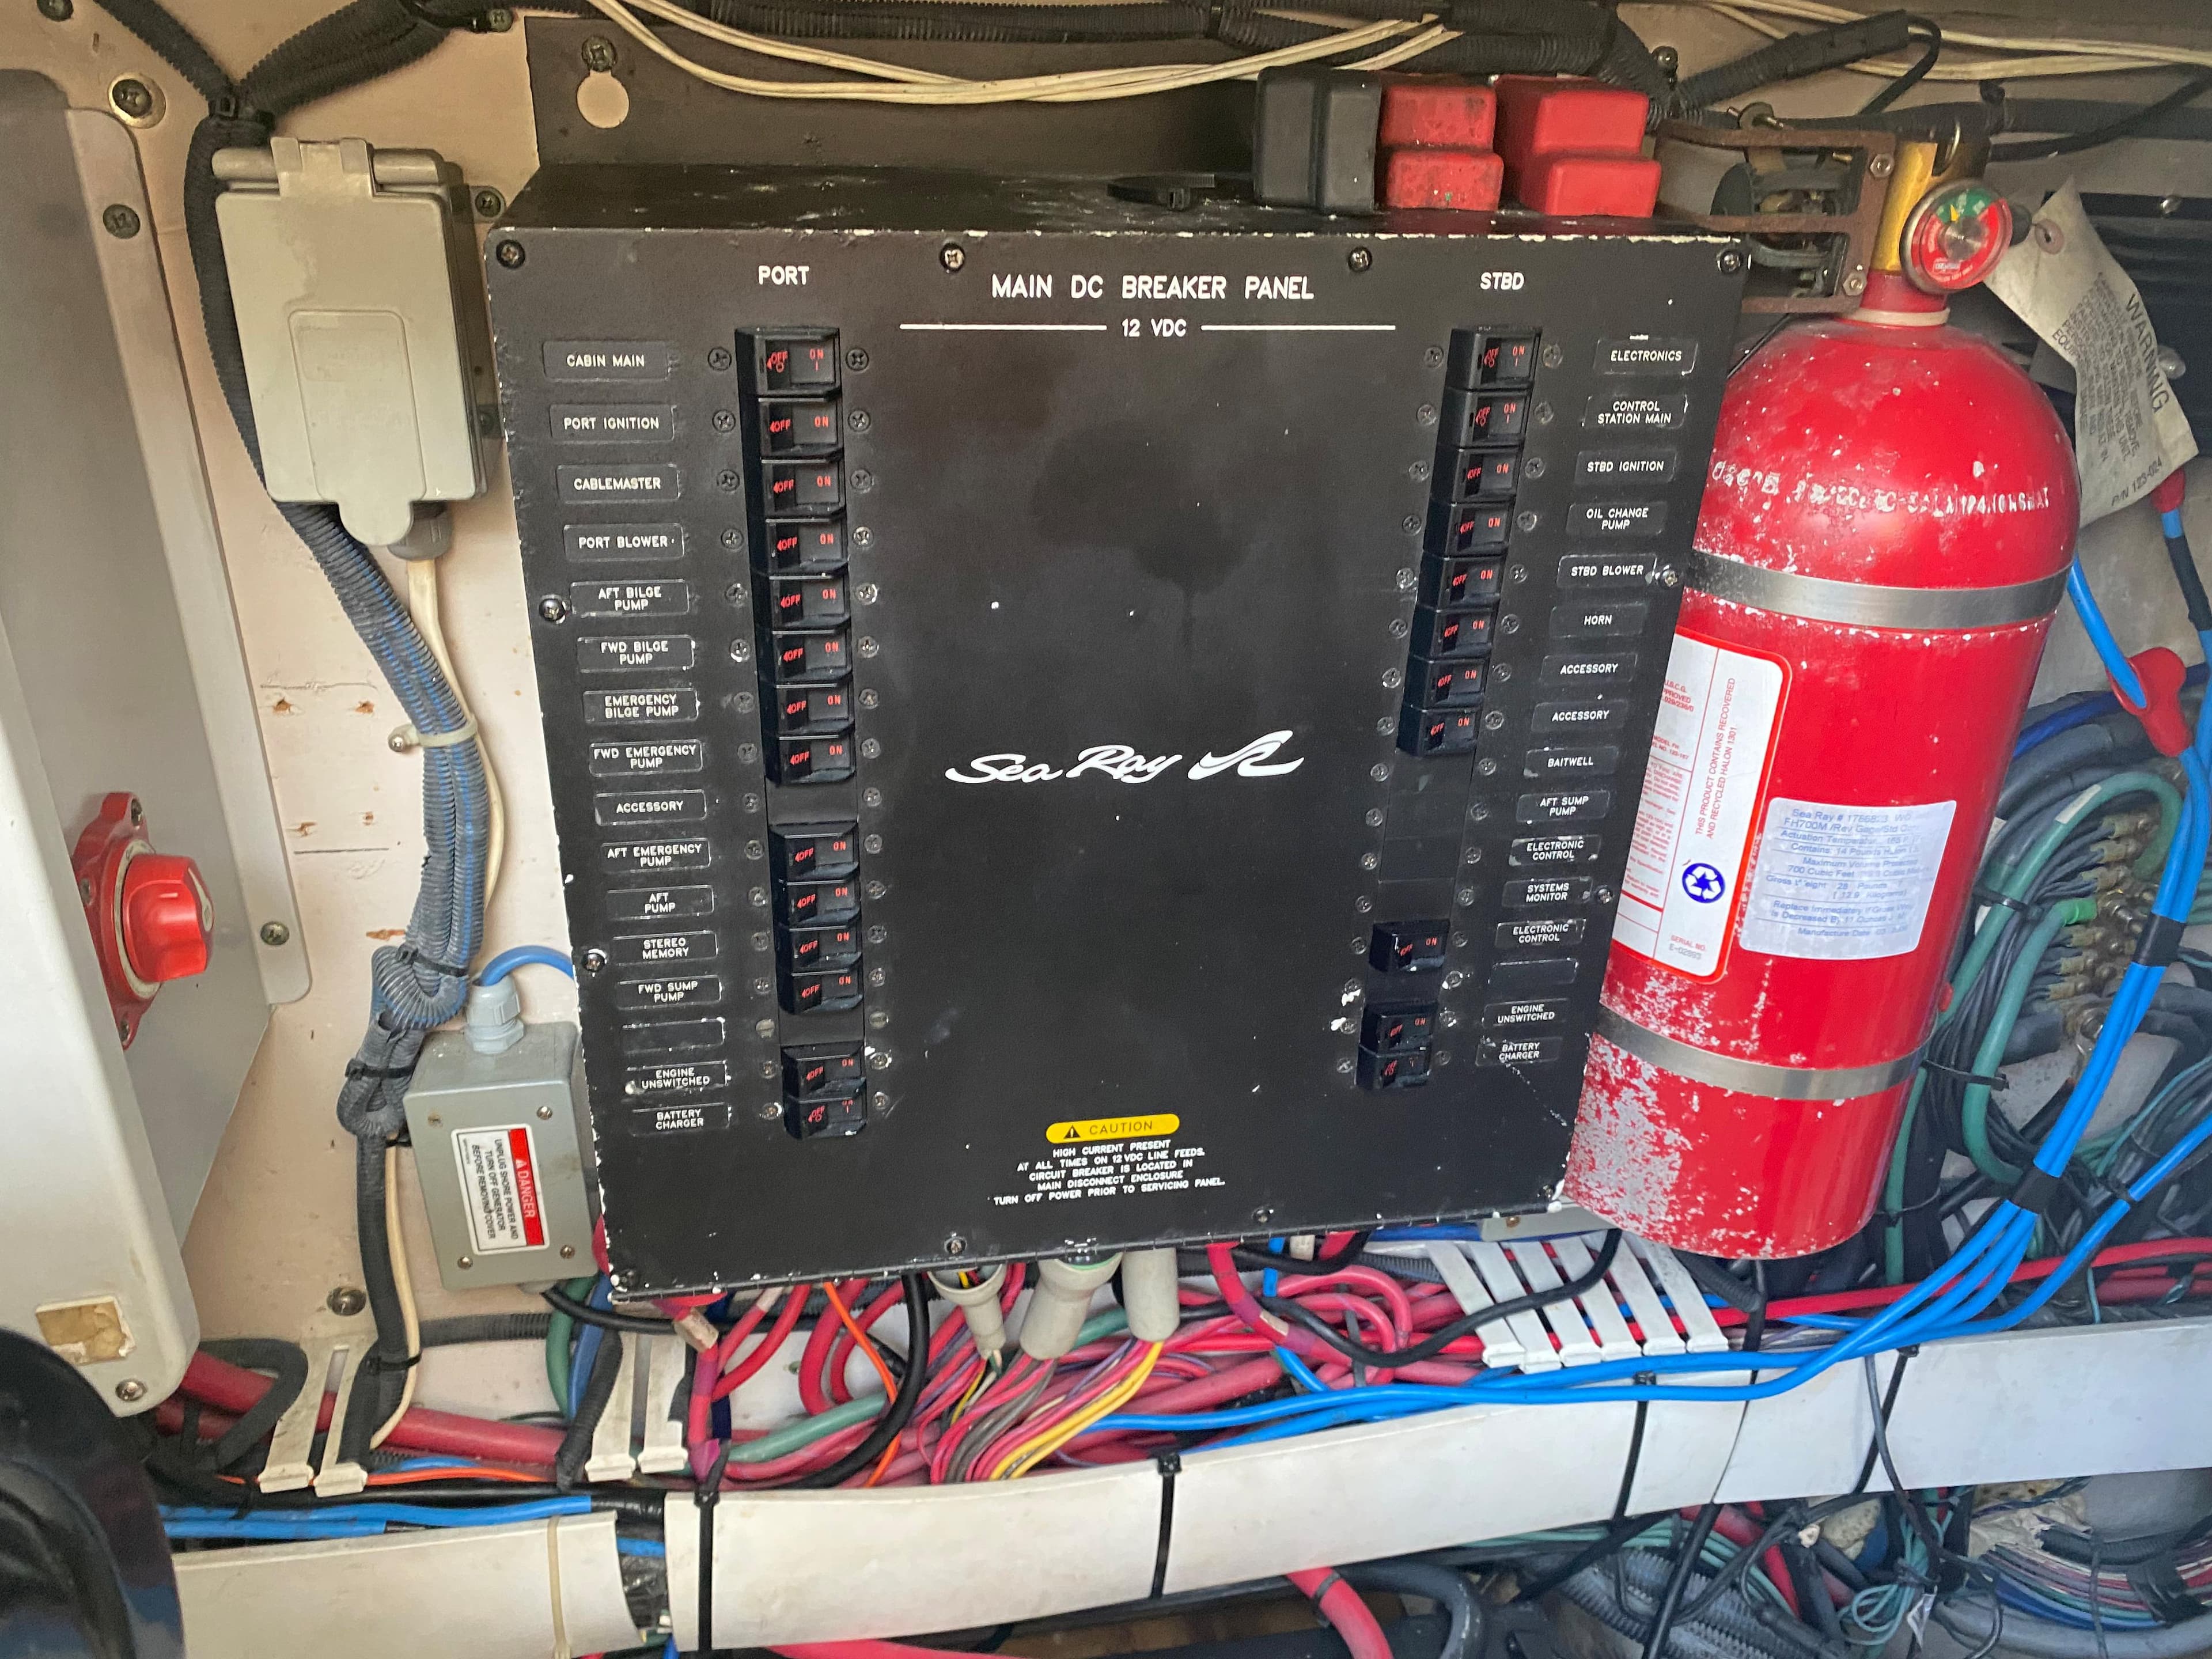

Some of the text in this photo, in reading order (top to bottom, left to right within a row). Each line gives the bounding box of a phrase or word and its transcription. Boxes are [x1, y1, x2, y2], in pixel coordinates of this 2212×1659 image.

[758, 266, 809, 285] PORT
[1480, 272, 1524, 290] STBD
[992, 274, 1314, 300] MAIN DC BREAKER PANEL
[1122, 319, 1187, 337] 12 VDC
[1611, 350, 1682, 361] ELECTRONICS
[2126, 293, 2169, 413] WARNING
[567, 354, 645, 367] CABIN MAIN
[1613, 401, 1660, 411] CONTROL
[564, 416, 659, 430] PORT IGNITION
[815, 416, 830, 427] ON
[1597, 412, 1671, 424] STATION MAIN
[1587, 461, 1664, 472] STBD IGNITION
[574, 477, 661, 490] CABLEMASTER
[817, 476, 831, 487] ON
[1586, 507, 1649, 518] OIL CHANGE
[1601, 520, 1630, 530] PUMP
[578, 535, 668, 548] PORT BLOWER
[820, 533, 834, 544] ON
[1571, 565, 1643, 577] STBD BLOWER
[599, 586, 662, 600] AFT BILGE
[614, 599, 649, 611] PUMP
[1584, 615, 1612, 626] HORN
[601, 641, 668, 654] FWD BILGE
[619, 653, 653, 665] PUMP
[1560, 663, 1618, 675] ACCESSORY
[605, 694, 677, 707] EMERGENCY
[605, 706, 679, 718] BILGE PUMP
[1552, 710, 1609, 722] ACCESSORY
[594, 745, 696, 760] FWD EMERGENCY
[1695, 678, 1736, 834] THIS PRODUCT CONTAINS RECOVERED
[630, 757, 662, 769] PUMP
[945, 745, 1183, 783] Sea Ray
[1548, 756, 1593, 768] BAITWELL
[1720, 747, 1732, 775] HALON
[1540, 796, 1589, 807] AFT SUMP
[1710, 777, 1726, 820] RECYCLED
[616, 801, 683, 813] ACCESSORY
[1550, 806, 1576, 816] PUMP
[1793, 809, 1834, 822] Sea Ray
[1706, 821, 1716, 839] AND
[1784, 817, 1827, 831] FH700M
[1781, 830, 1823, 842] Actuation
[607, 843, 702, 858] AFT EMERGENCY
[1527, 840, 1584, 852] ELECTRONIC
[640, 855, 672, 868] PUMP
[1532, 850, 1574, 861] CONTROL
[1803, 857, 1846, 867] Maximum
[1787, 865, 1805, 873] 700
[1807, 868, 1833, 876] Cubic
[1766, 874, 1792, 885] Gross
[1527, 882, 1569, 893] SYSTEMS
[649, 892, 669, 903] AFT
[1526, 892, 1567, 903] MONITOR
[644, 902, 676, 914] PUMP
[1773, 900, 1809, 911] Replace
[1782, 911, 1827, 922] Decreased
[1513, 923, 1569, 935] ELECTRONIC
[1798, 927, 1849, 937] Manufacture
[643, 937, 686, 949] STEREO
[1518, 933, 1560, 944] CONTROL
[642, 947, 689, 960] MEMORY
[638, 981, 698, 994] FWD SUMP
[654, 992, 684, 1003] PUMP
[1512, 1003, 1544, 1014] ENGINE
[1498, 1012, 1555, 1023] UNSWITCHED
[1502, 1042, 1540, 1052] BATTERY
[1499, 1051, 1539, 1060] CHARGER
[656, 1067, 695, 1079] ENGINE
[641, 1076, 710, 1089] UNSWITCHED
[657, 1108, 701, 1121] BATTERY
[656, 1118, 704, 1130] CHARGER
[1090, 1121, 1152, 1134] CAUTION
[1053, 1139, 1171, 1158] HIGH CURRENT PRESENT
[1017, 1162, 1029, 1172] AT
[1035, 1161, 1053, 1170] ALL
[1060, 1158, 1088, 1168] TIMES
[1094, 1156, 1107, 1165] ON
[1112, 1154, 1122, 1163] 12
[1124, 1153, 1143, 1162] VDC
[1147, 1150, 1169, 1160] LINE
[1029, 1159, 1192, 1181] CIRCUIT BREAKER IS LOCATED IN
[1037, 1170, 1183, 1191] MAIN DISCONNECT ENCLOSURE
[472, 1145, 495, 1239] BEFORE REMOVING COVER
[485, 1150, 505, 1231] TURN OFF GENERATOR
[495, 1139, 518, 1239] UNPLUG SHORE POWER AND
[517, 1172, 535, 1218] DANGER
[994, 1177, 1225, 1206] TURN OFF POWER PRIOR TO SERVICING PANEL.
